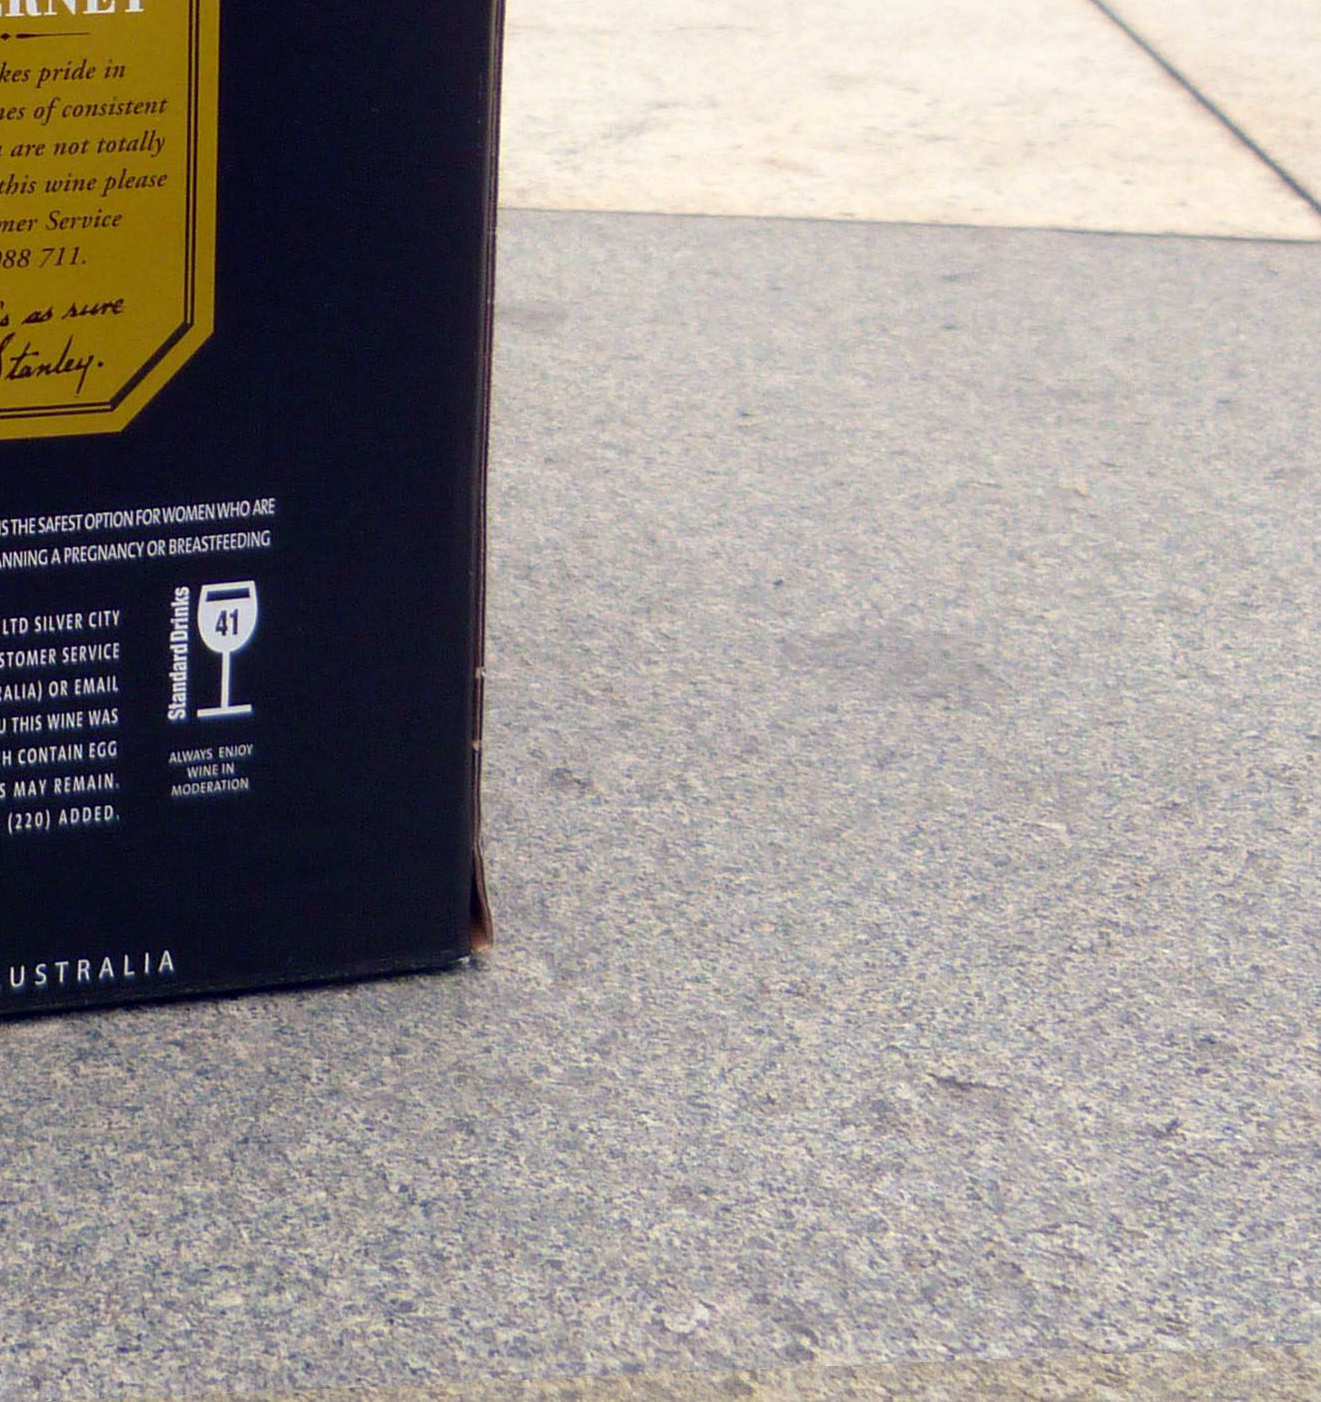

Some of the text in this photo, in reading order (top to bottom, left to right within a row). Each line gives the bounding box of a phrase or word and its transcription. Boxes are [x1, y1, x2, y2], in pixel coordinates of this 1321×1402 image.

[36, 58, 96, 89] pride
[104, 58, 126, 79] in
[33, 97, 61, 126] of
[61, 95, 168, 119] consistent
[10, 142, 45, 158] are
[53, 138, 89, 156] not
[96, 129, 165, 158] totally
[45, 172, 97, 194] wine
[100, 167, 168, 198] please
[45, 208, 123, 231] Service
[39, 246, 87, 268] 711.
[21, 304, 53, 325] as
[61, 298, 125, 321] sure
[10, 516, 36, 536] THE
[38, 513, 83, 534] SAFEST
[84, 510, 135, 530] OPTION
[135, 507, 162, 526] FOR
[161, 503, 216, 524] WOMEN
[216, 500, 250, 520] WHO
[252, 498, 276, 516] ARE
[50, 547, 61, 565] A
[63, 541, 144, 564] PREGNANCY
[146, 539, 166, 558] OR
[168, 529, 272, 555] BREASTFEEDING
[2, 616, 28, 636] LTD
[34, 612, 83, 633] SILVER
[88, 609, 120, 629] CITY
[214, 608, 239, 637] 41
[62, 642, 120, 664] SERVICE
[48, 679, 68, 698] OR
[74, 675, 119, 696] EMAIL
[11, 714, 42, 734] THIS
[47, 711, 84, 731] WINE
[88, 707, 119, 727] WAS
[17, 744, 83, 766] CONTAIN
[88, 740, 118, 759] EGG
[168, 744, 254, 764] ALWAYS ENJOY
[187, 762, 235, 779] WINE IN
[13, 778, 47, 798] MAY
[53, 772, 120, 795] REMAIN.
[170, 777, 249, 797] MODERATION
[7, 809, 51, 834] (220)
[58, 804, 120, 826] ADDED.
